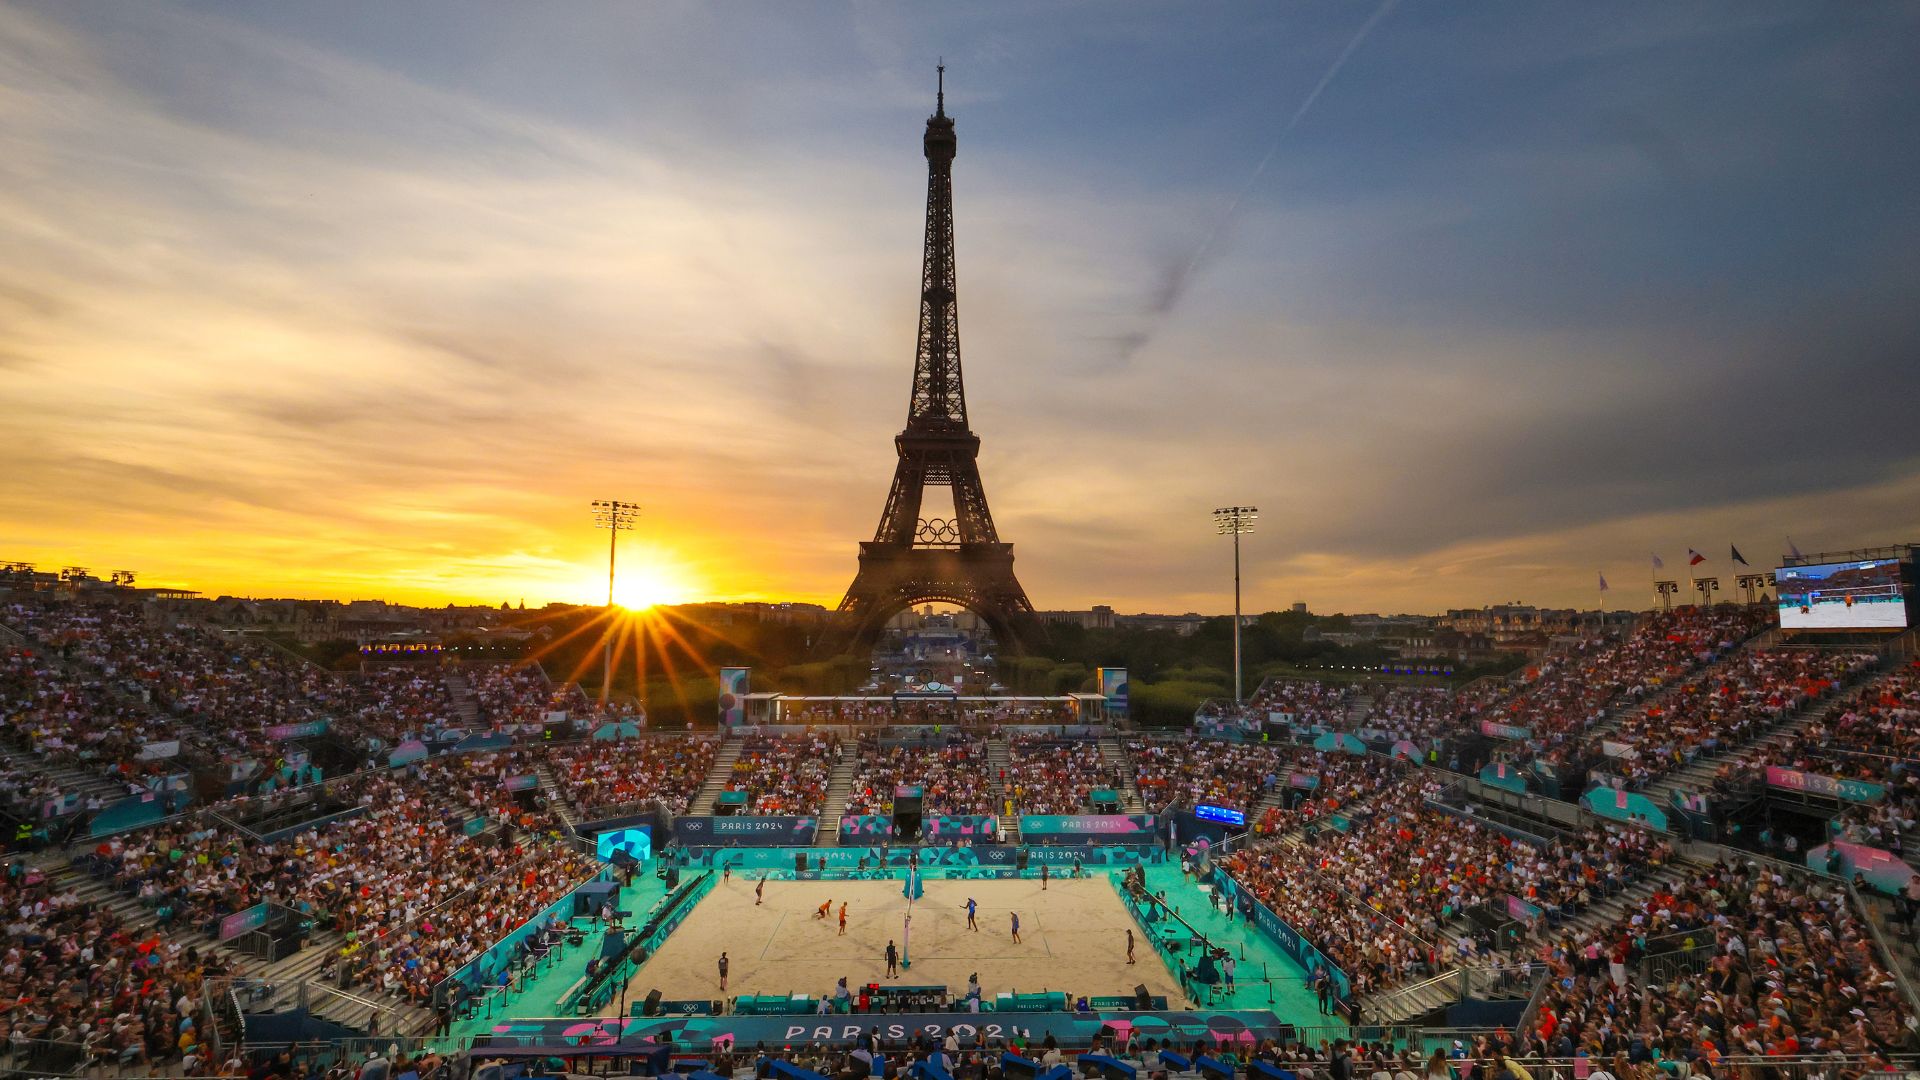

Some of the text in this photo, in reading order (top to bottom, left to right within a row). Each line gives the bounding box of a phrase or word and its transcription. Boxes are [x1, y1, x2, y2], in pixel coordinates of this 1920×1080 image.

[1781, 774, 1867, 797] PARIS 2024
[721, 822, 783, 830] PARIS 2024
[1062, 821, 1121, 829] PARIS 2024
[824, 852, 852, 860] 2024
[1030, 851, 1055, 859] ARIS
[1258, 912, 1296, 951] PARIS 2024
[785, 1023, 1031, 1039] PARS 2024
